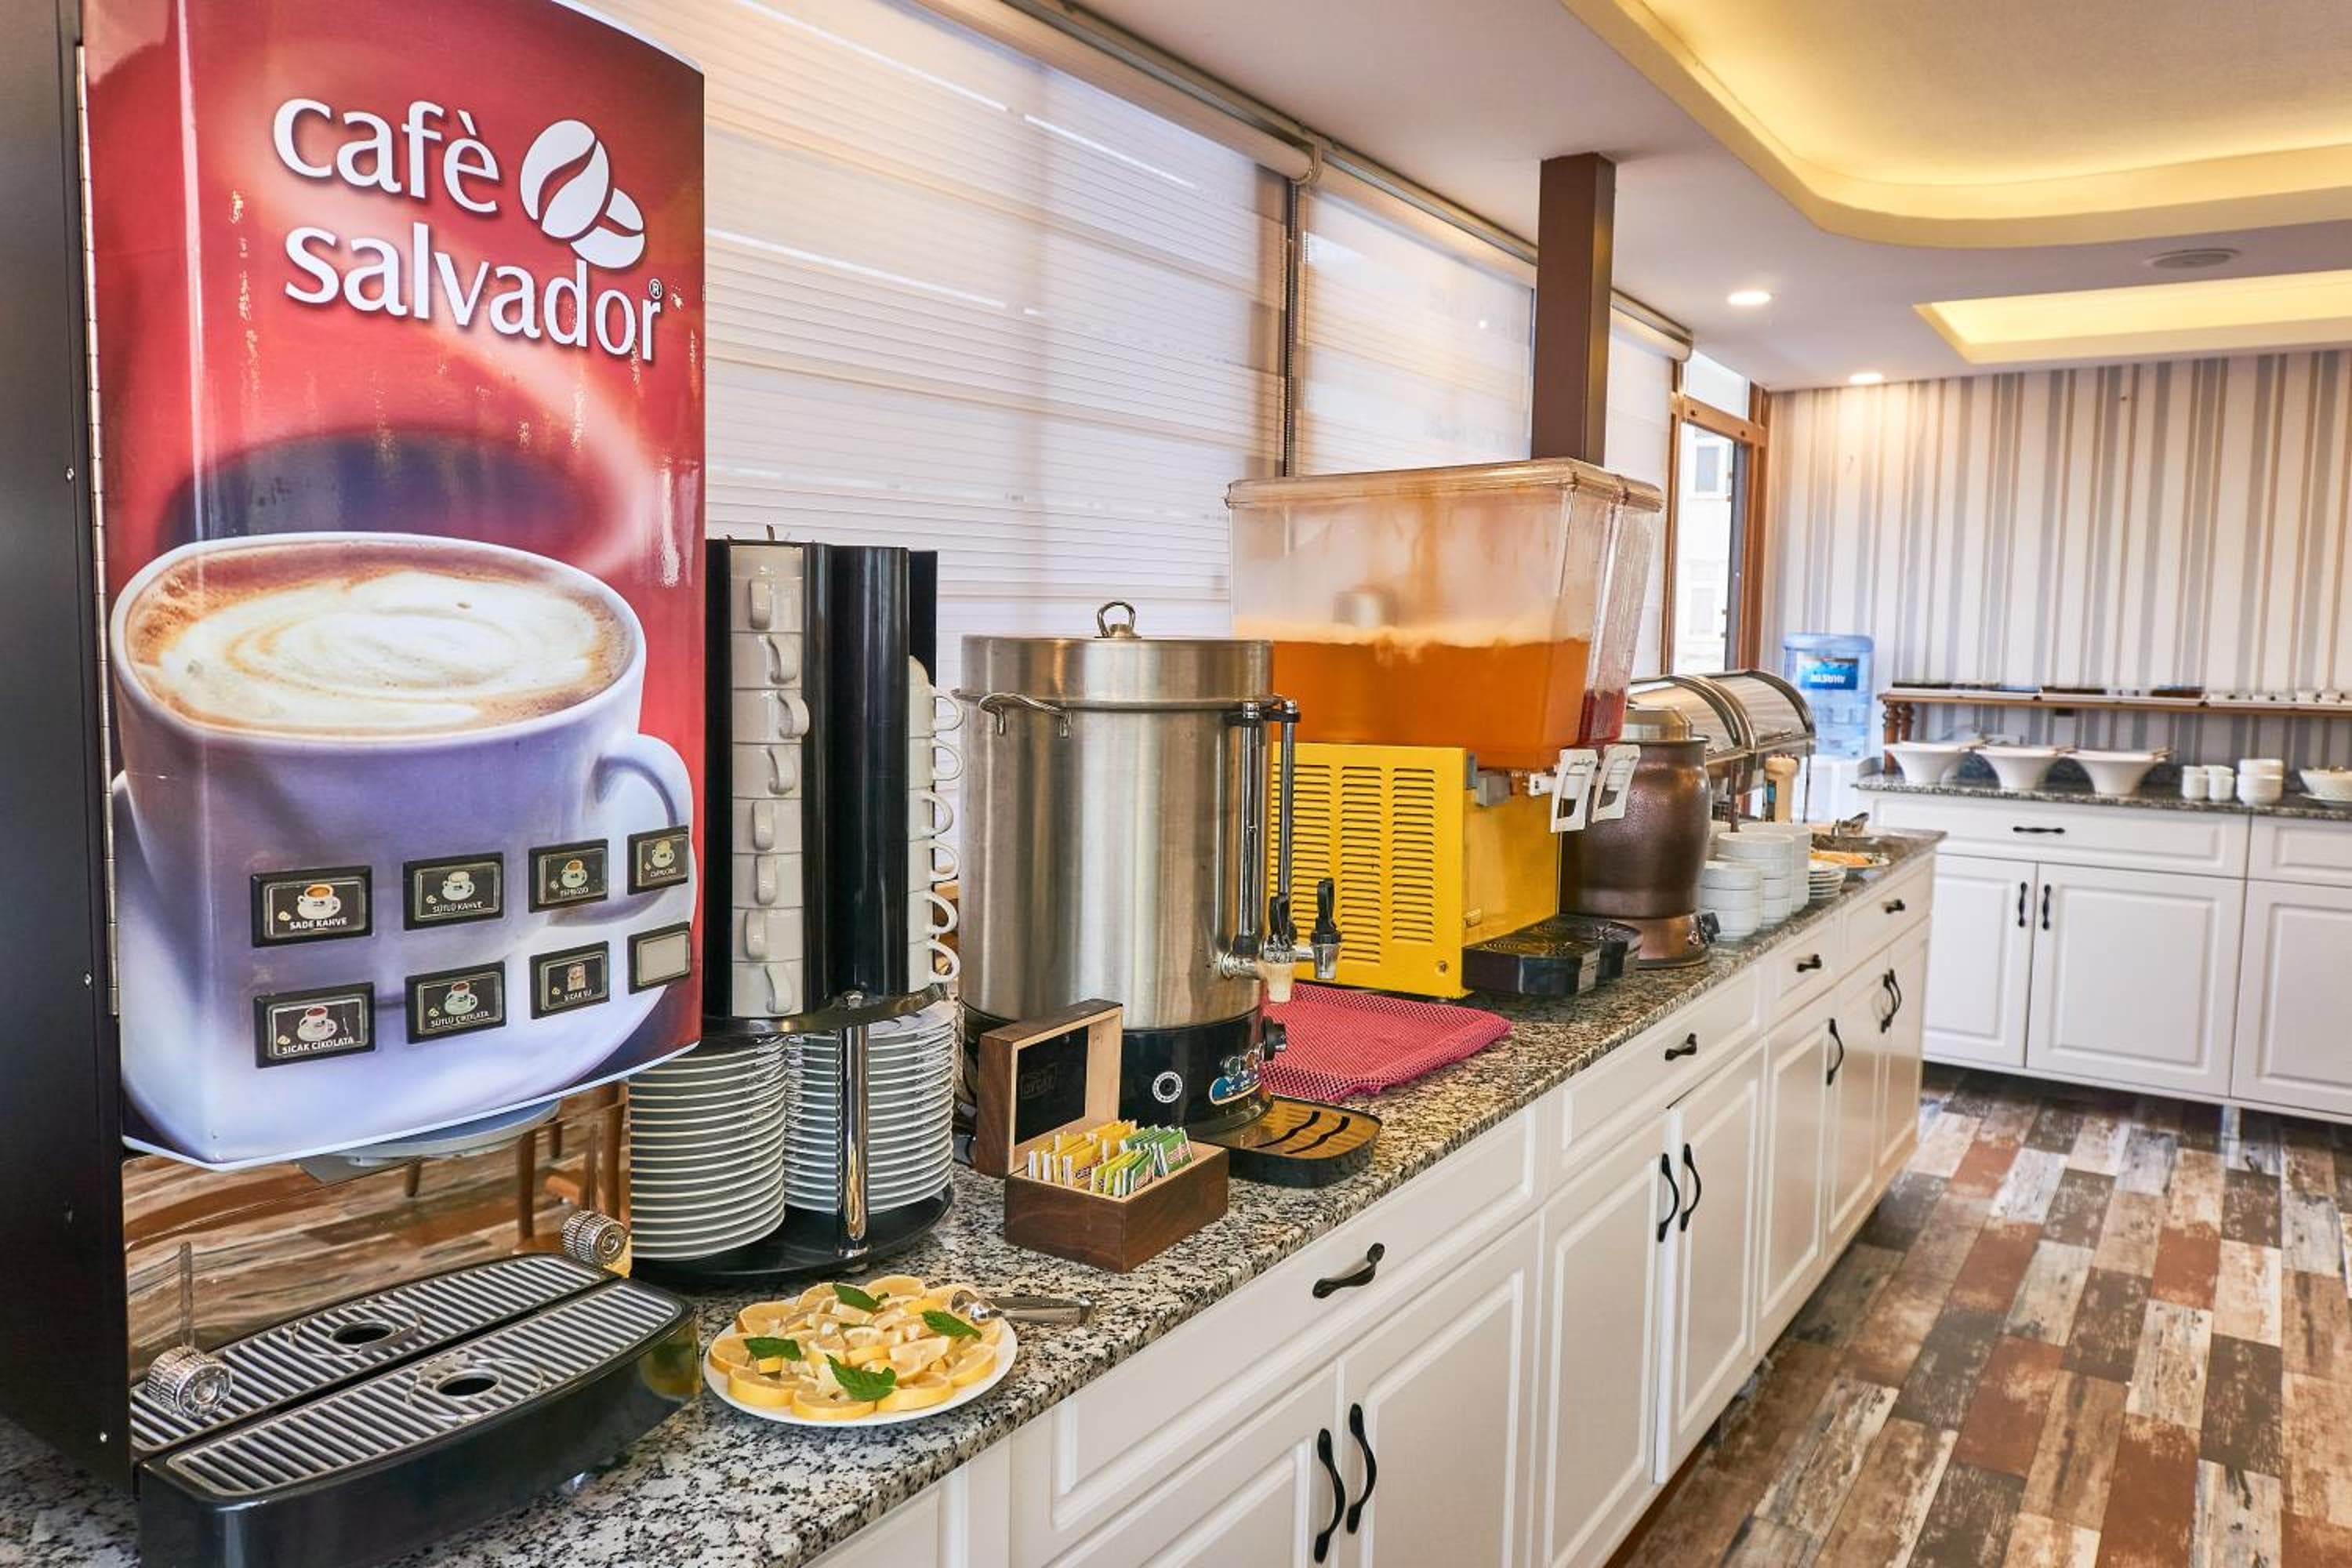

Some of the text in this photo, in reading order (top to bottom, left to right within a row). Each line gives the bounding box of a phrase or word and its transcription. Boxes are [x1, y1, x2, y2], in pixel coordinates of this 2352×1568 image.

[273, 99, 500, 212] cafè
[289, 917, 347, 931] SADE KAHVE
[281, 1043, 310, 1054] SICAK
